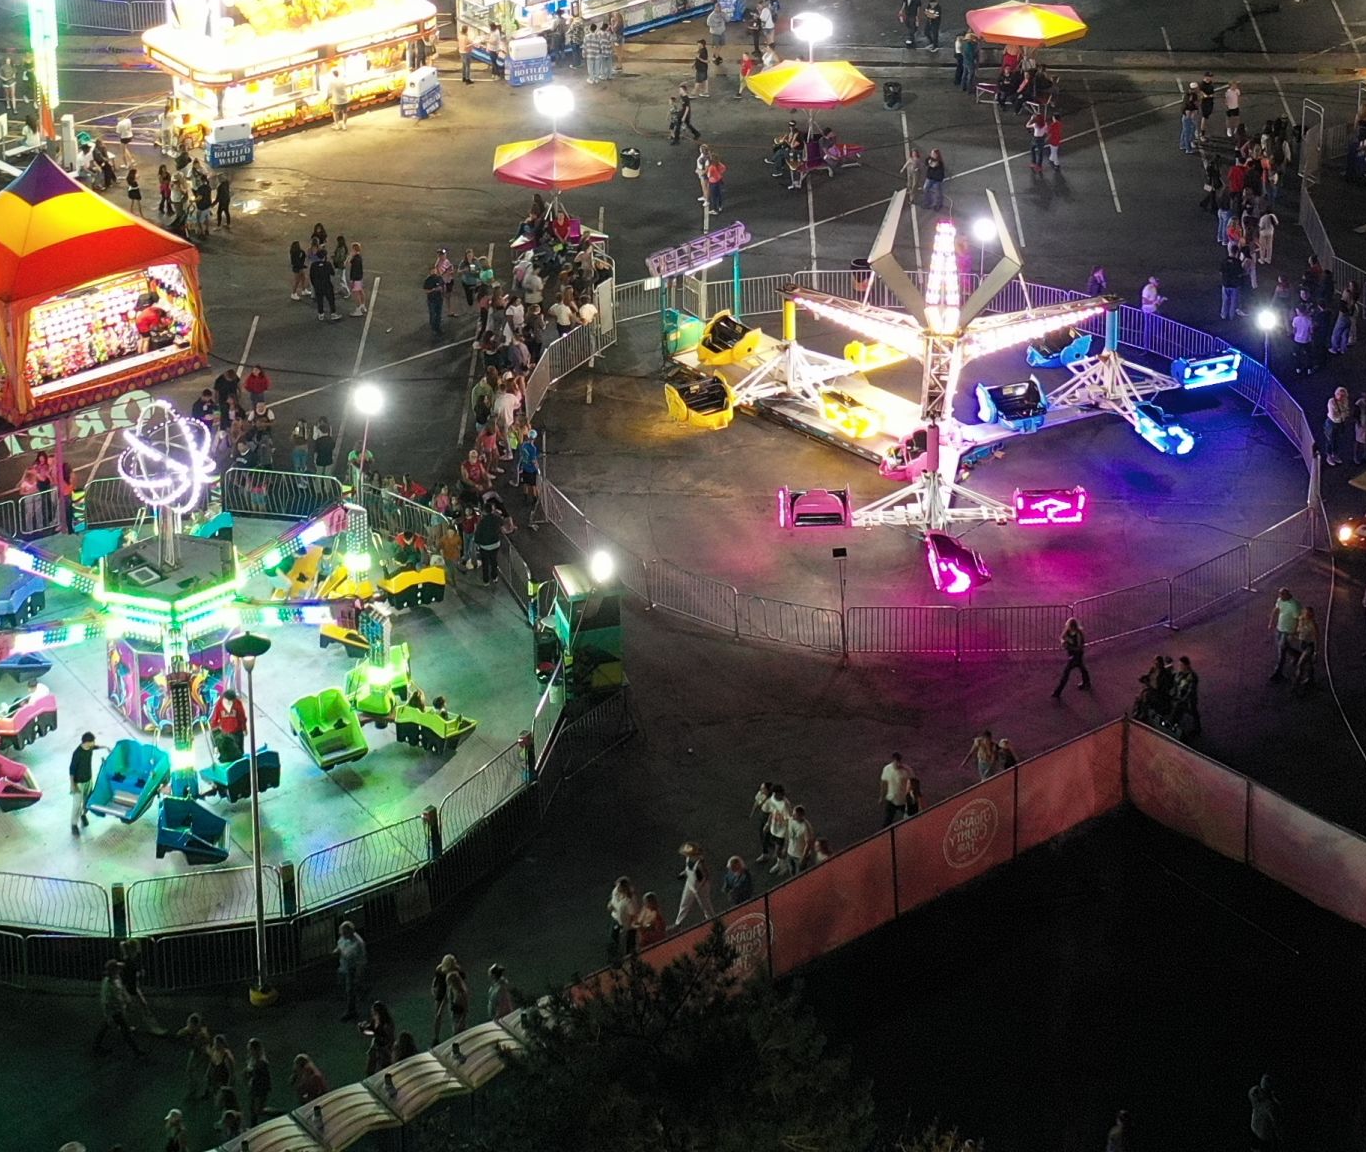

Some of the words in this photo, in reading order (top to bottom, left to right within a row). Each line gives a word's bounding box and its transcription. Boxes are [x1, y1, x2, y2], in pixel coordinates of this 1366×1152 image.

[514, 66, 549, 77] BOTTLED
[519, 74, 545, 84] WATER
[214, 147, 251, 159] BOTTLED
[219, 156, 247, 166] WATER
